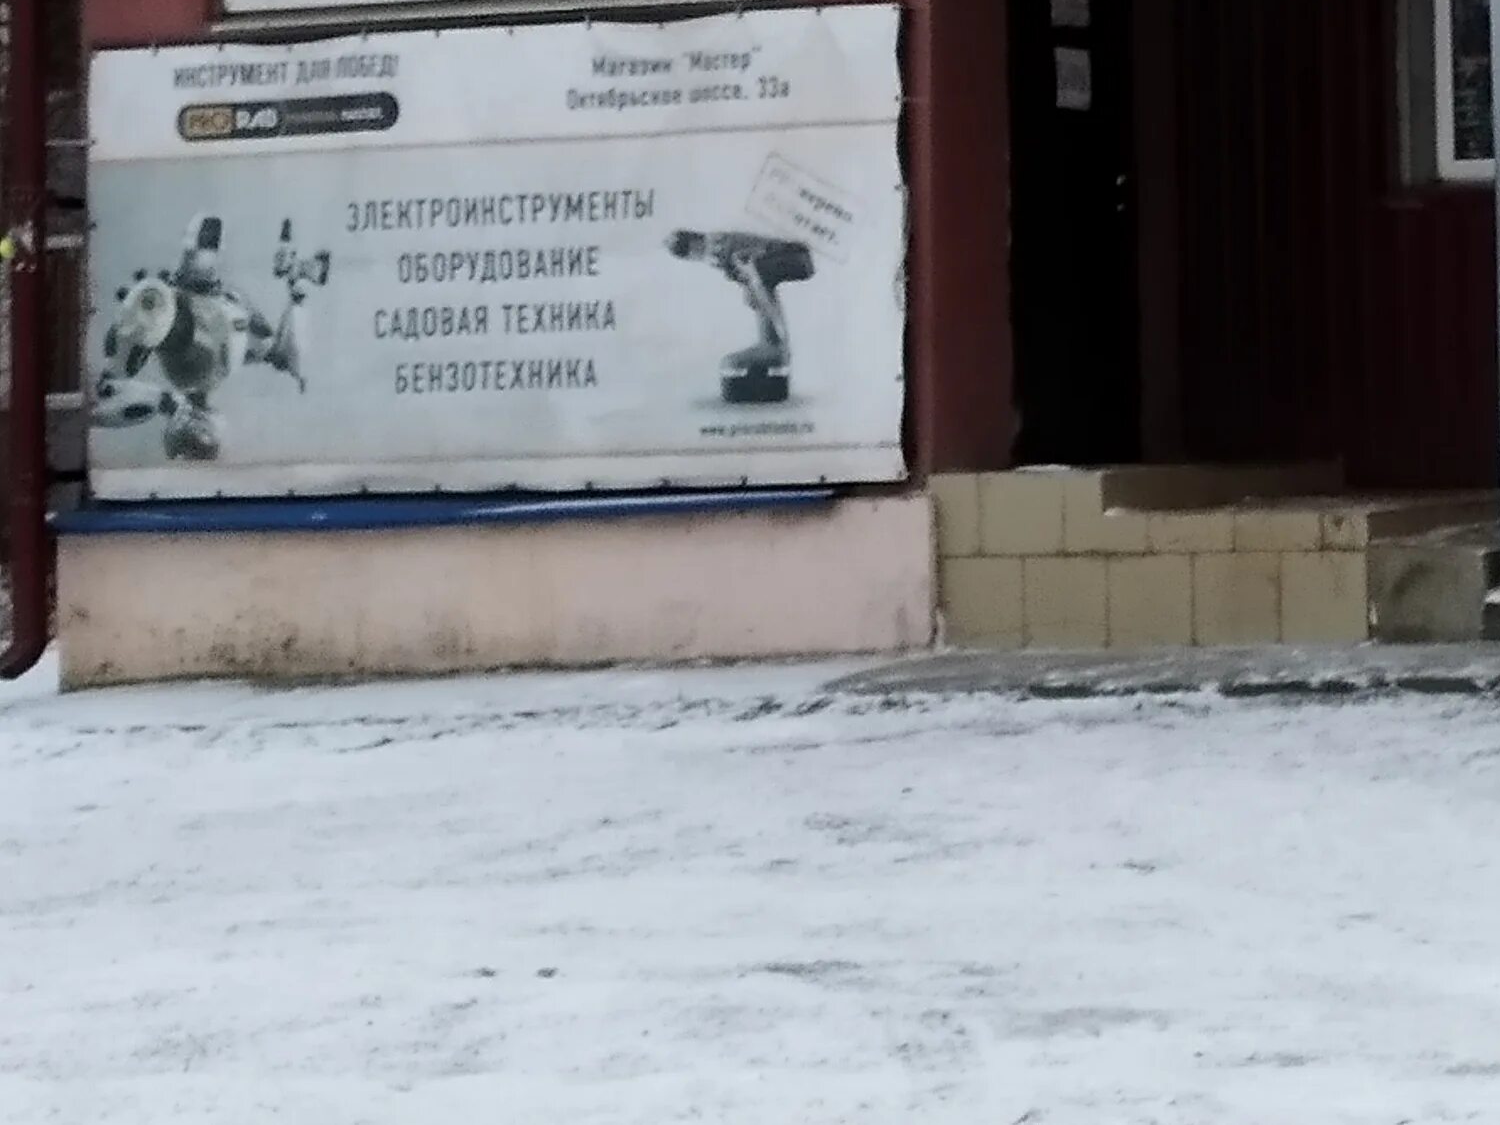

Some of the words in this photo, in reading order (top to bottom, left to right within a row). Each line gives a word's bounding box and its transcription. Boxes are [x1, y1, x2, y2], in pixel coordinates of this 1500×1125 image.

[174, 61, 288, 89] ИНСТРУМЕНТ
[592, 56, 673, 76] Магазин
[566, 87, 682, 111] Октябрьское
[347, 188, 655, 233] ЭЛЕКТРОИНСТРУМЕНТЫ
[397, 245, 600, 283] ОБОРУДОВАНИЕ
[374, 305, 490, 340] САДОВАЯ
[502, 300, 617, 335] ТЕХНИКА
[394, 359, 599, 394] БЕНЗОТЕХНИКА
